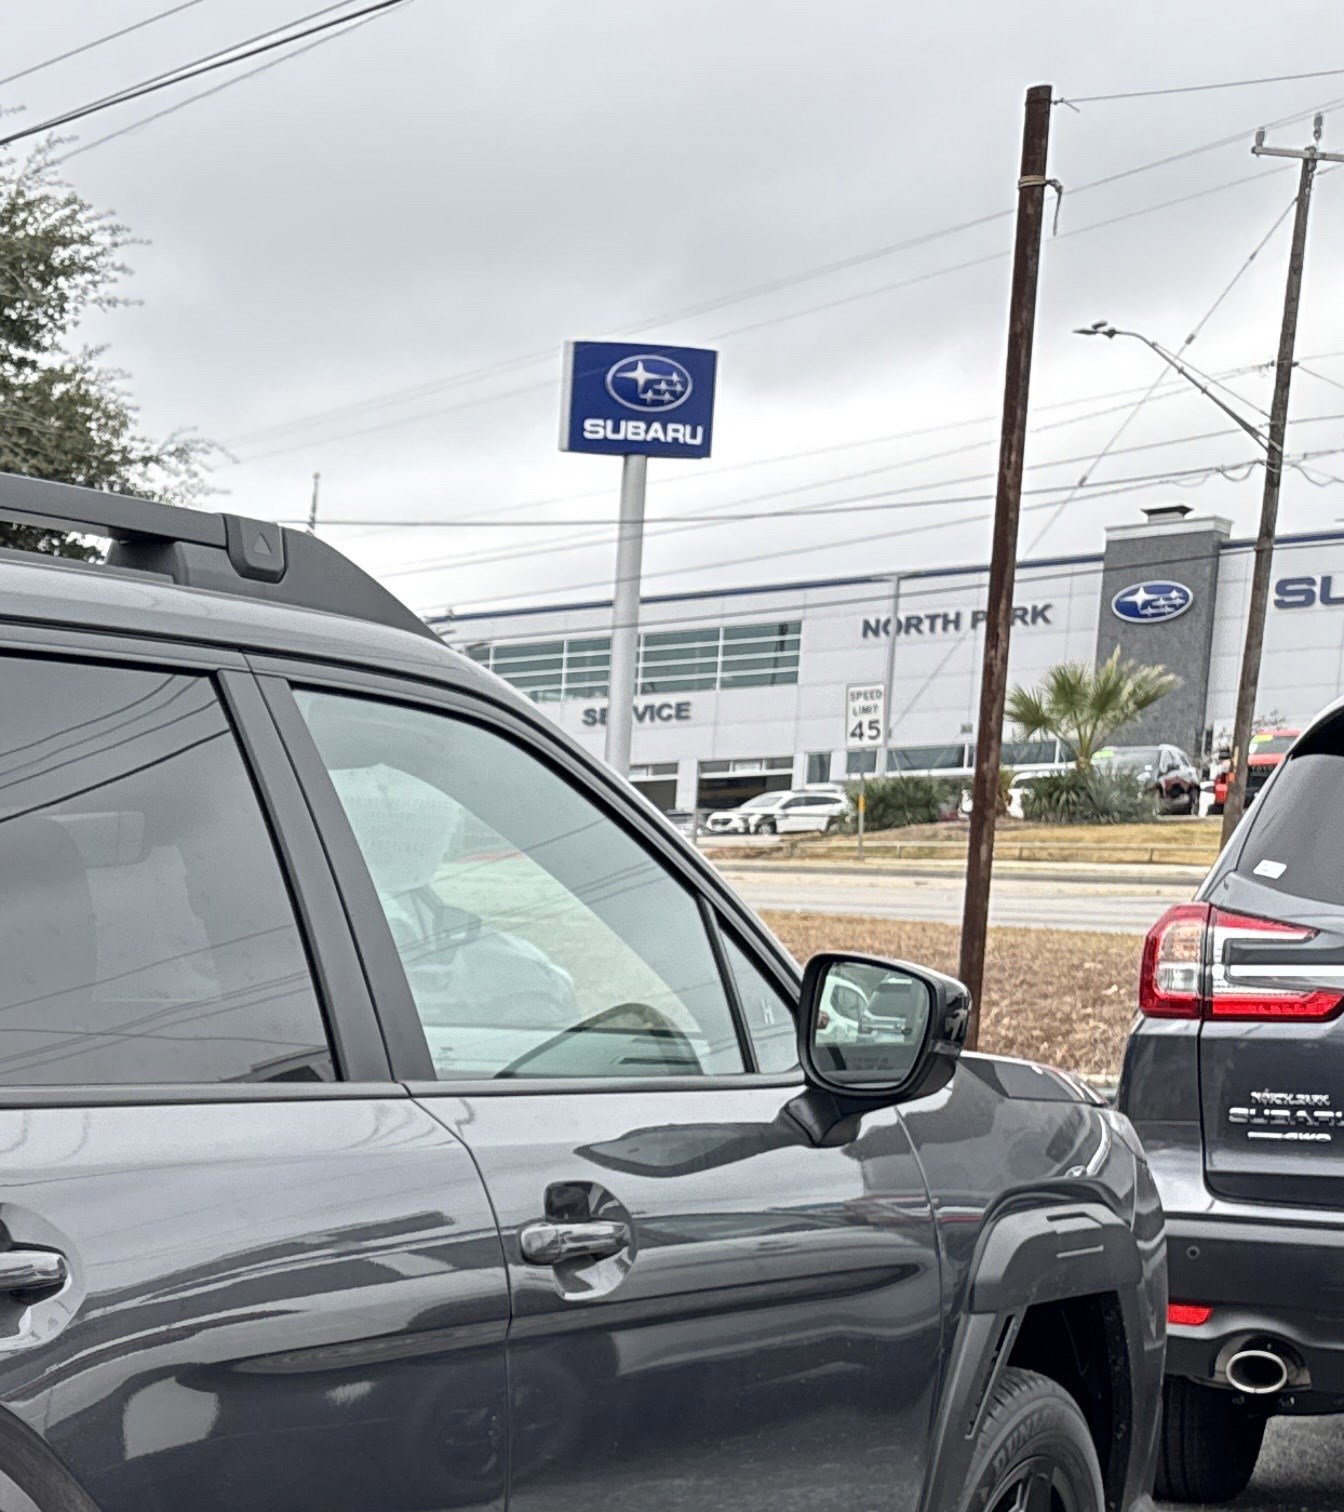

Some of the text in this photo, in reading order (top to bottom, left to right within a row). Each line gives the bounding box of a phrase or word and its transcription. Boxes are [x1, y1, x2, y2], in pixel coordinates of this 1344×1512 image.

[582, 417, 704, 446] SUBARU
[862, 603, 1053, 639] NORTH PRK
[850, 719, 881, 742] 45
